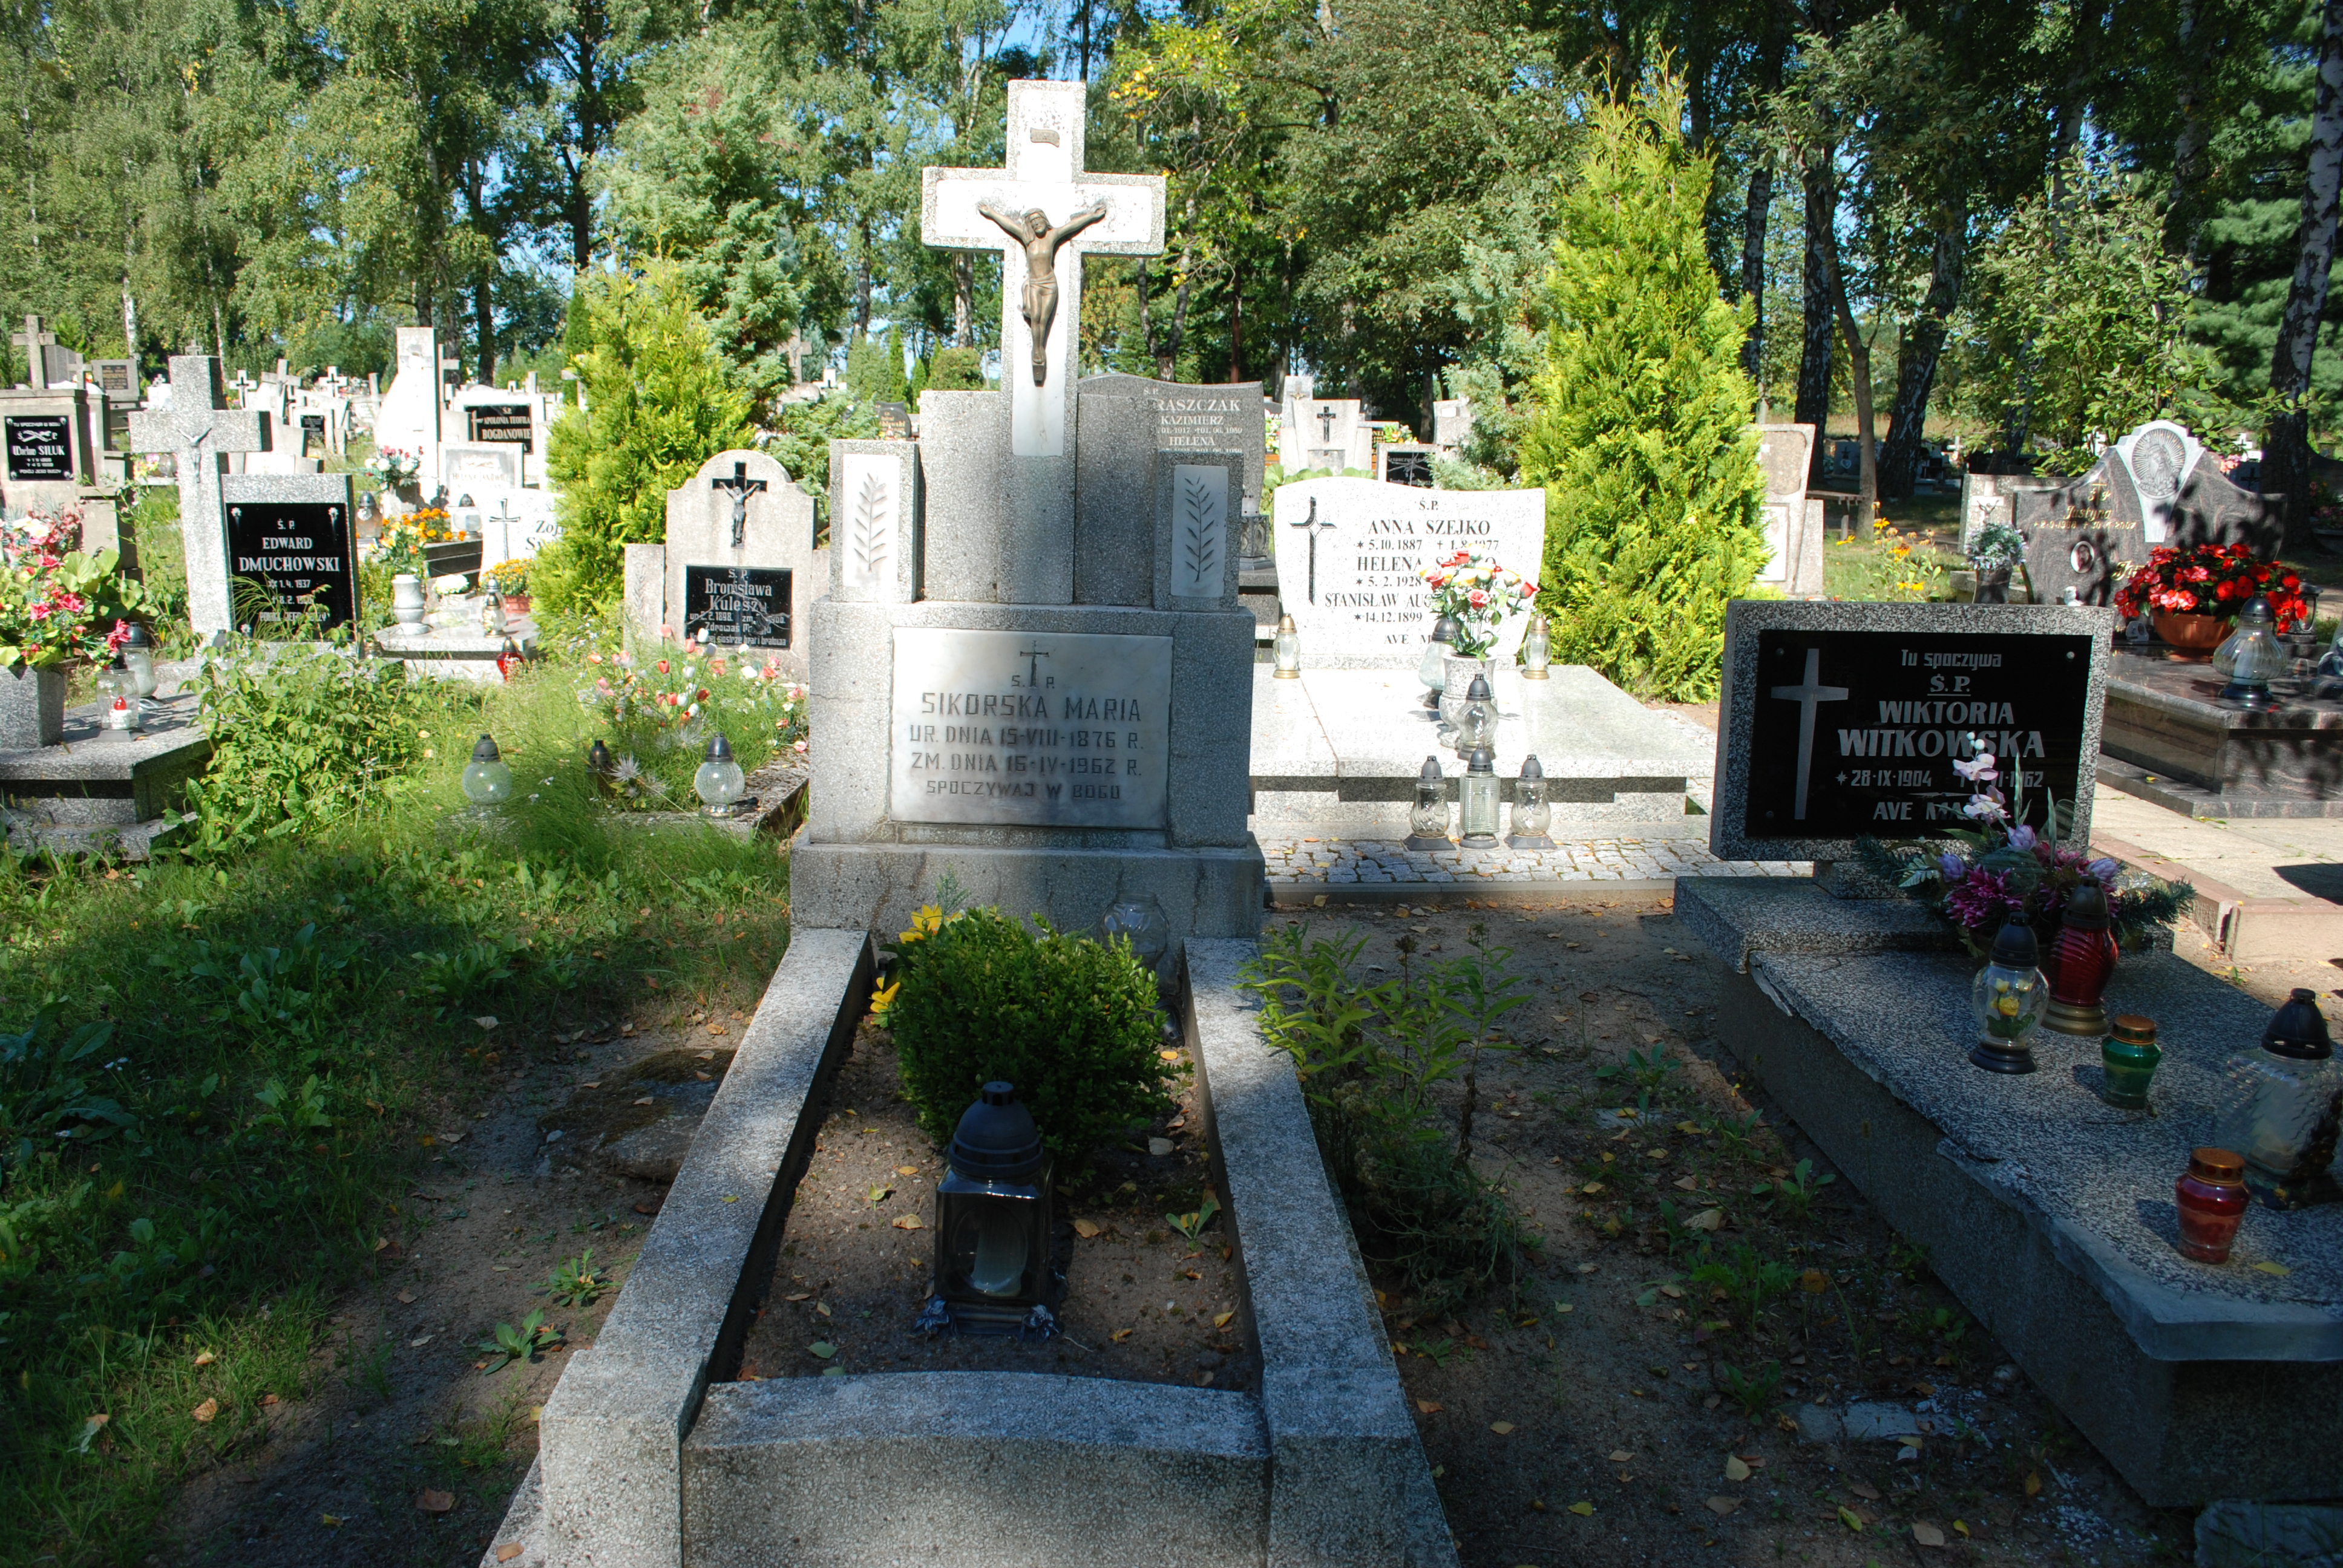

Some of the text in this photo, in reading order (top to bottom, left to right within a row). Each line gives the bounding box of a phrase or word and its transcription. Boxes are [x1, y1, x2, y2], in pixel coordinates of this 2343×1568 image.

[1161, 416, 1225, 425] KAZIMIERZ
[1168, 436, 1216, 446] HELENA
[38, 445, 65, 456] SILUK
[2063, 505, 2113, 522] Justyna
[1368, 520, 1491, 535] ANNA SZEJKO
[261, 537, 313, 549] EDWARD
[238, 557, 340, 572] DMUCHOWSKI
[1357, 556, 1422, 572] HELENA
[1383, 634, 1409, 645] AVE
[1901, 649, 2002, 671] Tu spoczywa
[921, 692, 1142, 722] SIKORSKA MARIA
[1878, 700, 2016, 725] WIKTORIA
[909, 724, 939, 743] UR.
[945, 725, 993, 746] DNIA
[1127, 732, 1144, 750] R.
[1837, 728, 2046, 758] WITKOWSKA
[911, 751, 946, 771] ZM.
[951, 753, 998, 773] DNIA
[1126, 759, 1142, 777] R.
[926, 780, 1121, 800] SPOCZYWAJ W BOGU
[1873, 802, 1913, 821] AVE
